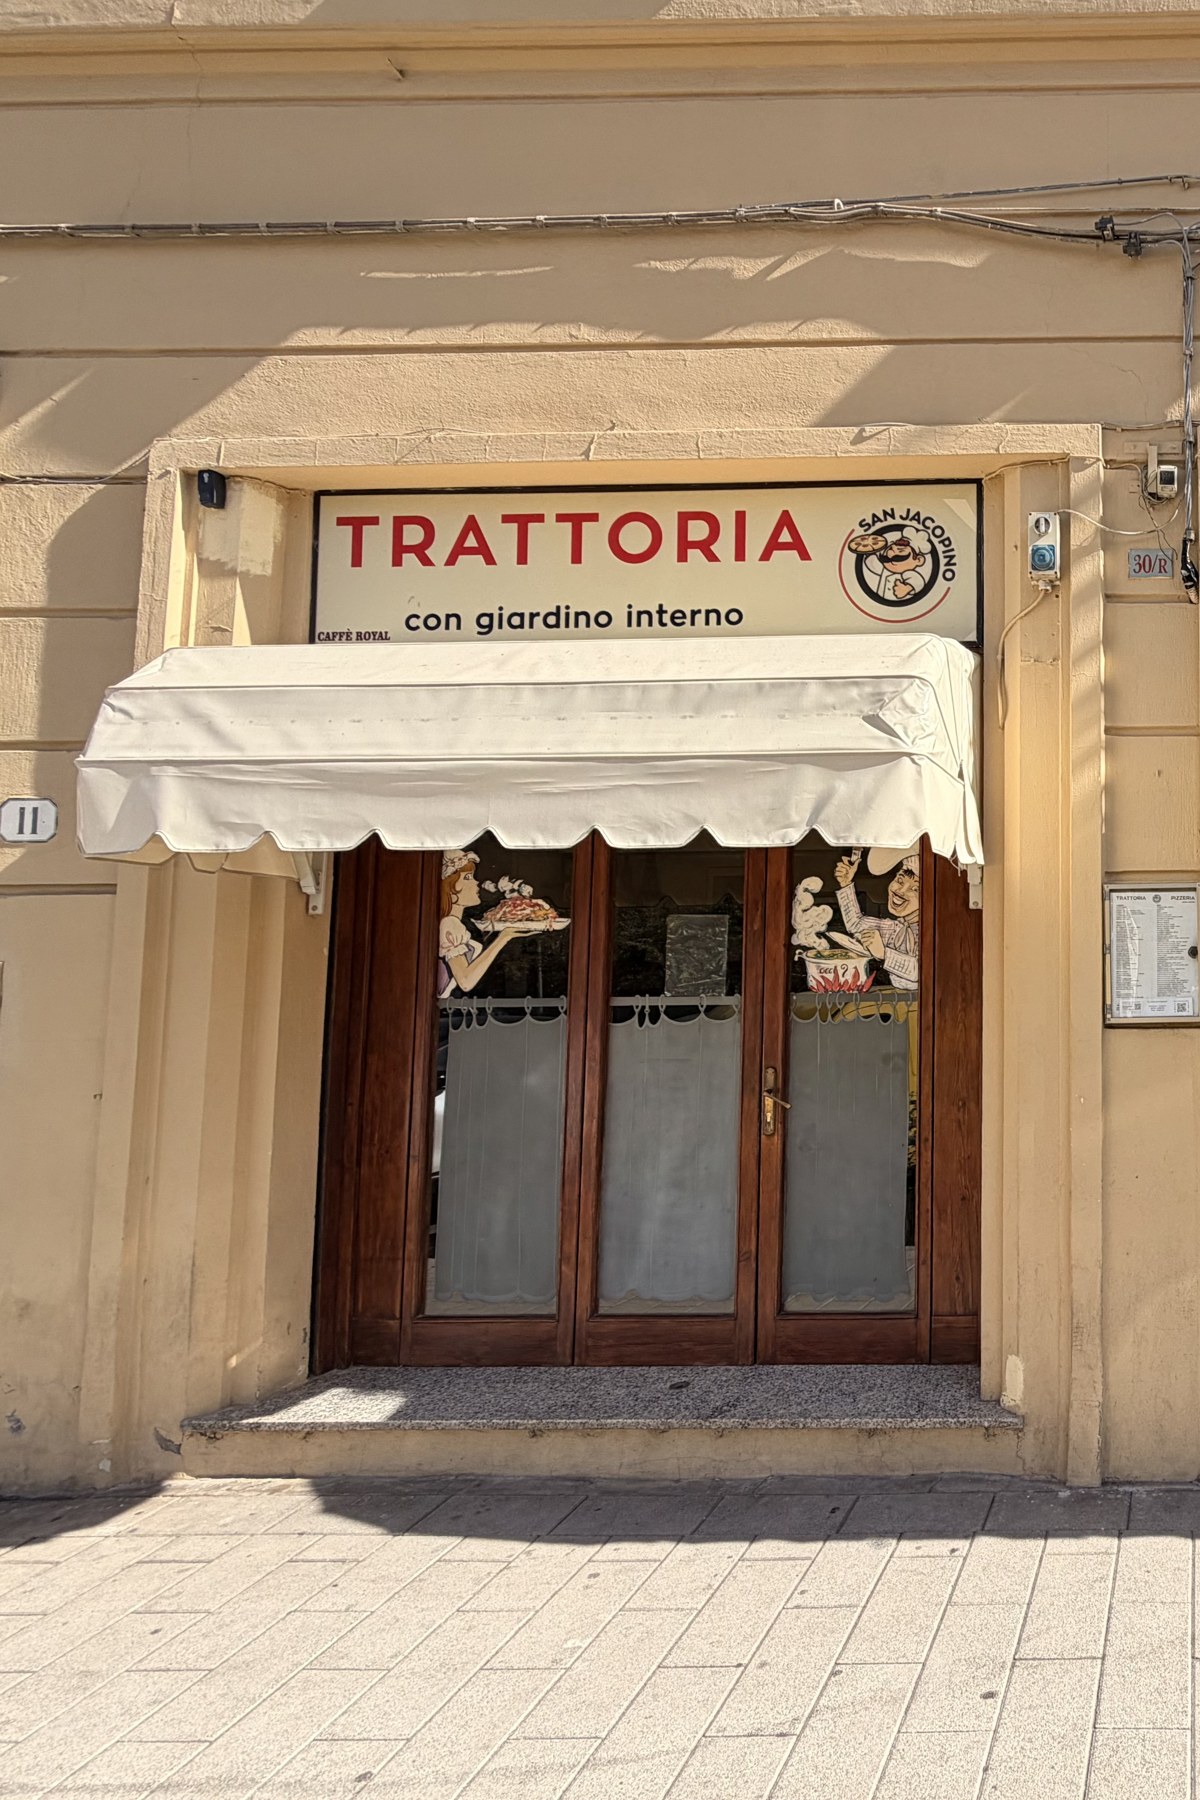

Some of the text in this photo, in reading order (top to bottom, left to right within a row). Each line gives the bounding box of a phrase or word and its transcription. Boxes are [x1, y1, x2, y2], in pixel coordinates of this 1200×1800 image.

[336, 509, 812, 568] TRATTORIA
[858, 507, 957, 582] SAN JACOPINO
[1132, 553, 1168, 574] 30/R
[317, 628, 391, 641] CAFFÈ ROYAL
[404, 603, 744, 636] con giardino interno
